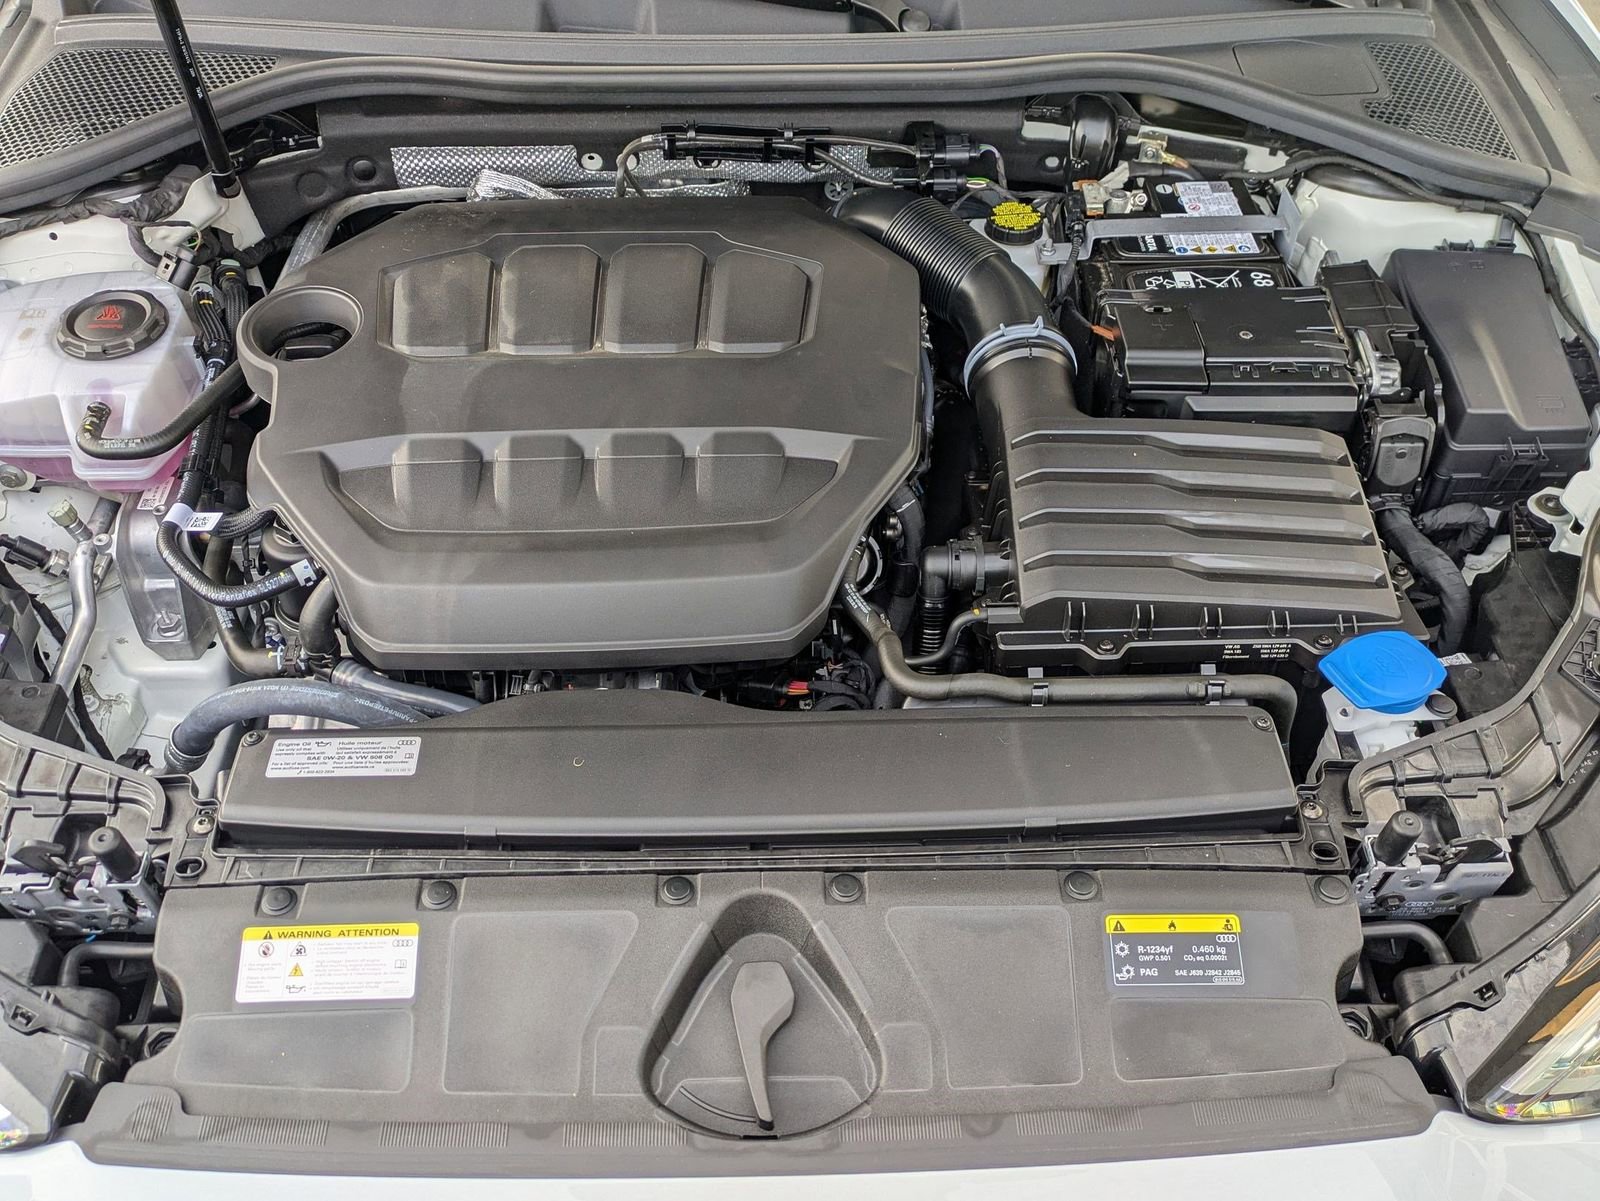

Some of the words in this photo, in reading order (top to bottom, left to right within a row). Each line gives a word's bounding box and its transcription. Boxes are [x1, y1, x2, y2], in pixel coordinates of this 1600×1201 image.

[278, 930, 332, 938] WARNING
[338, 928, 400, 936] ATTENTION
[1138, 945, 1173, 954] R-1234yf
[1216, 945, 1226, 955] kg
